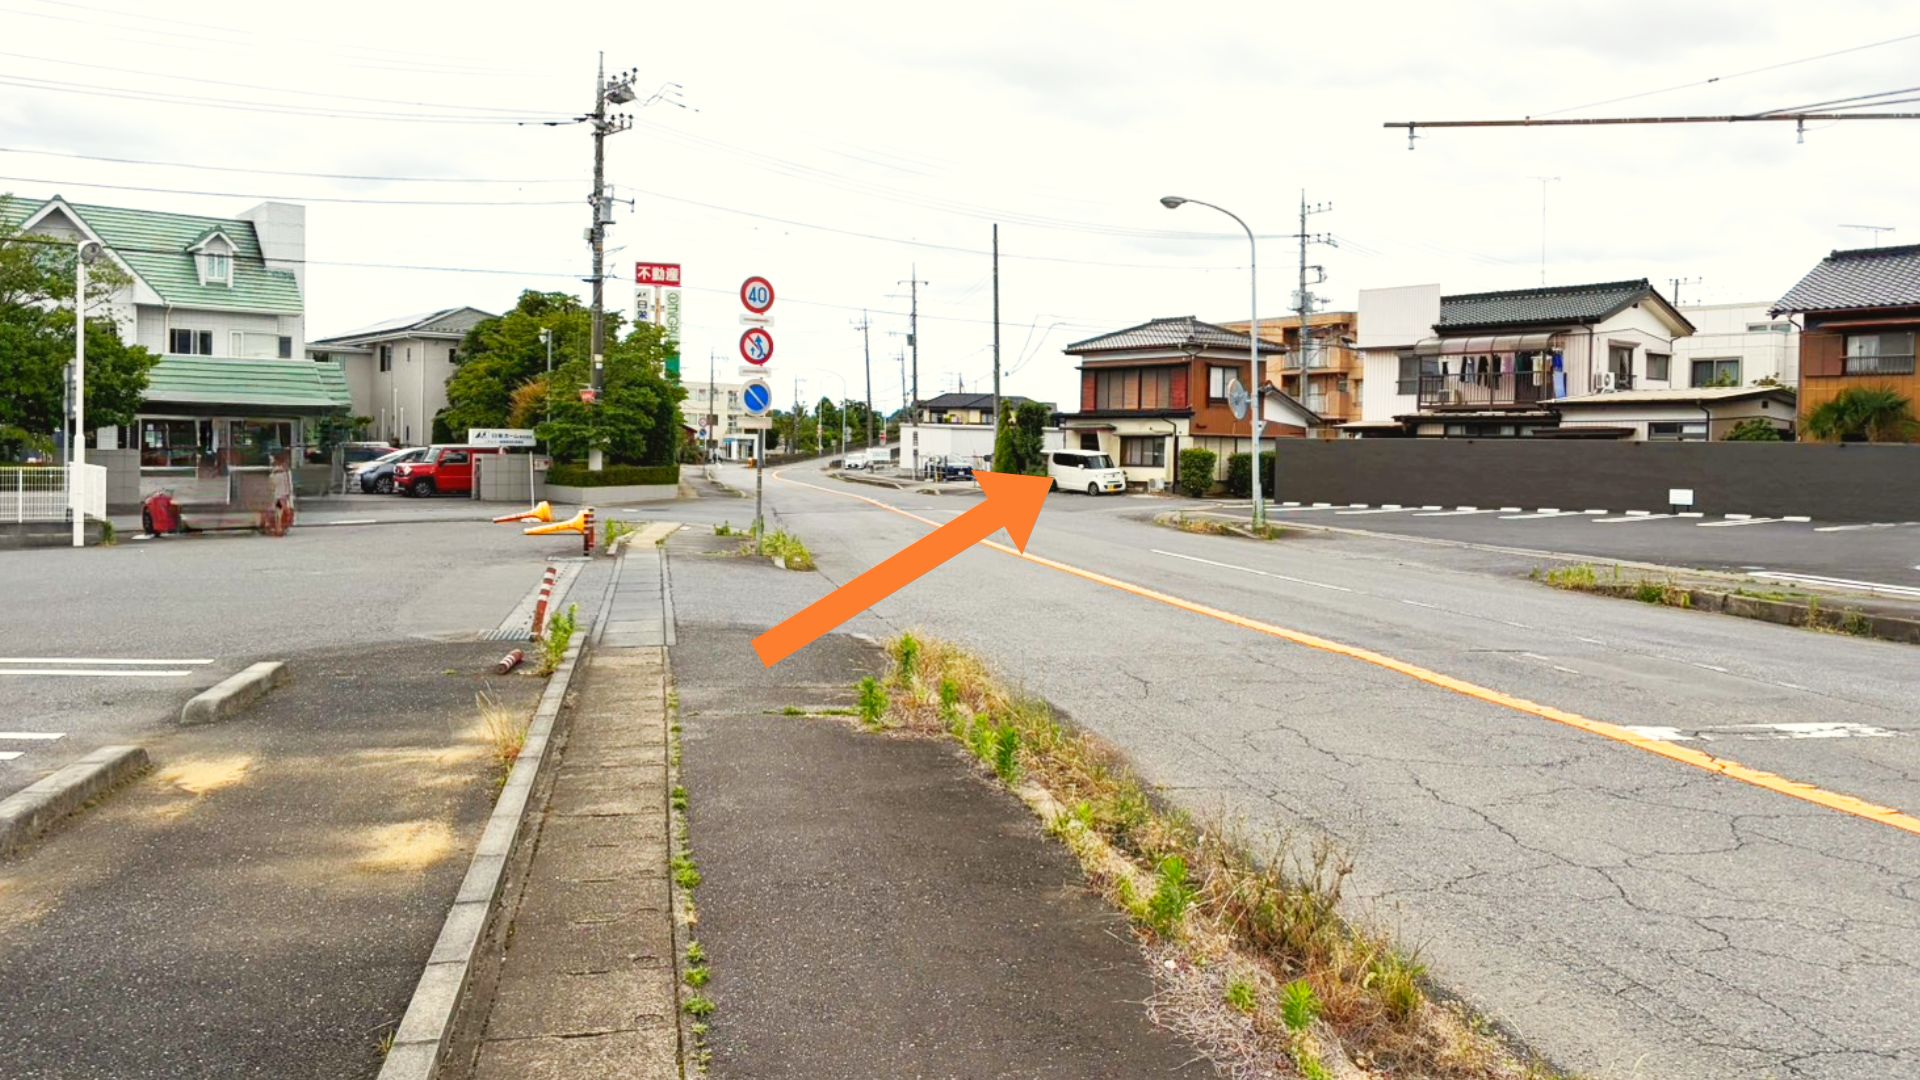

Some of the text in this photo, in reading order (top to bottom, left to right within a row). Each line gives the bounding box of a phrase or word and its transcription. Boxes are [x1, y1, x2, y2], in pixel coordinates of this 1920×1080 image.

[637, 265, 680, 282] 不動産
[748, 286, 768, 304] 40
